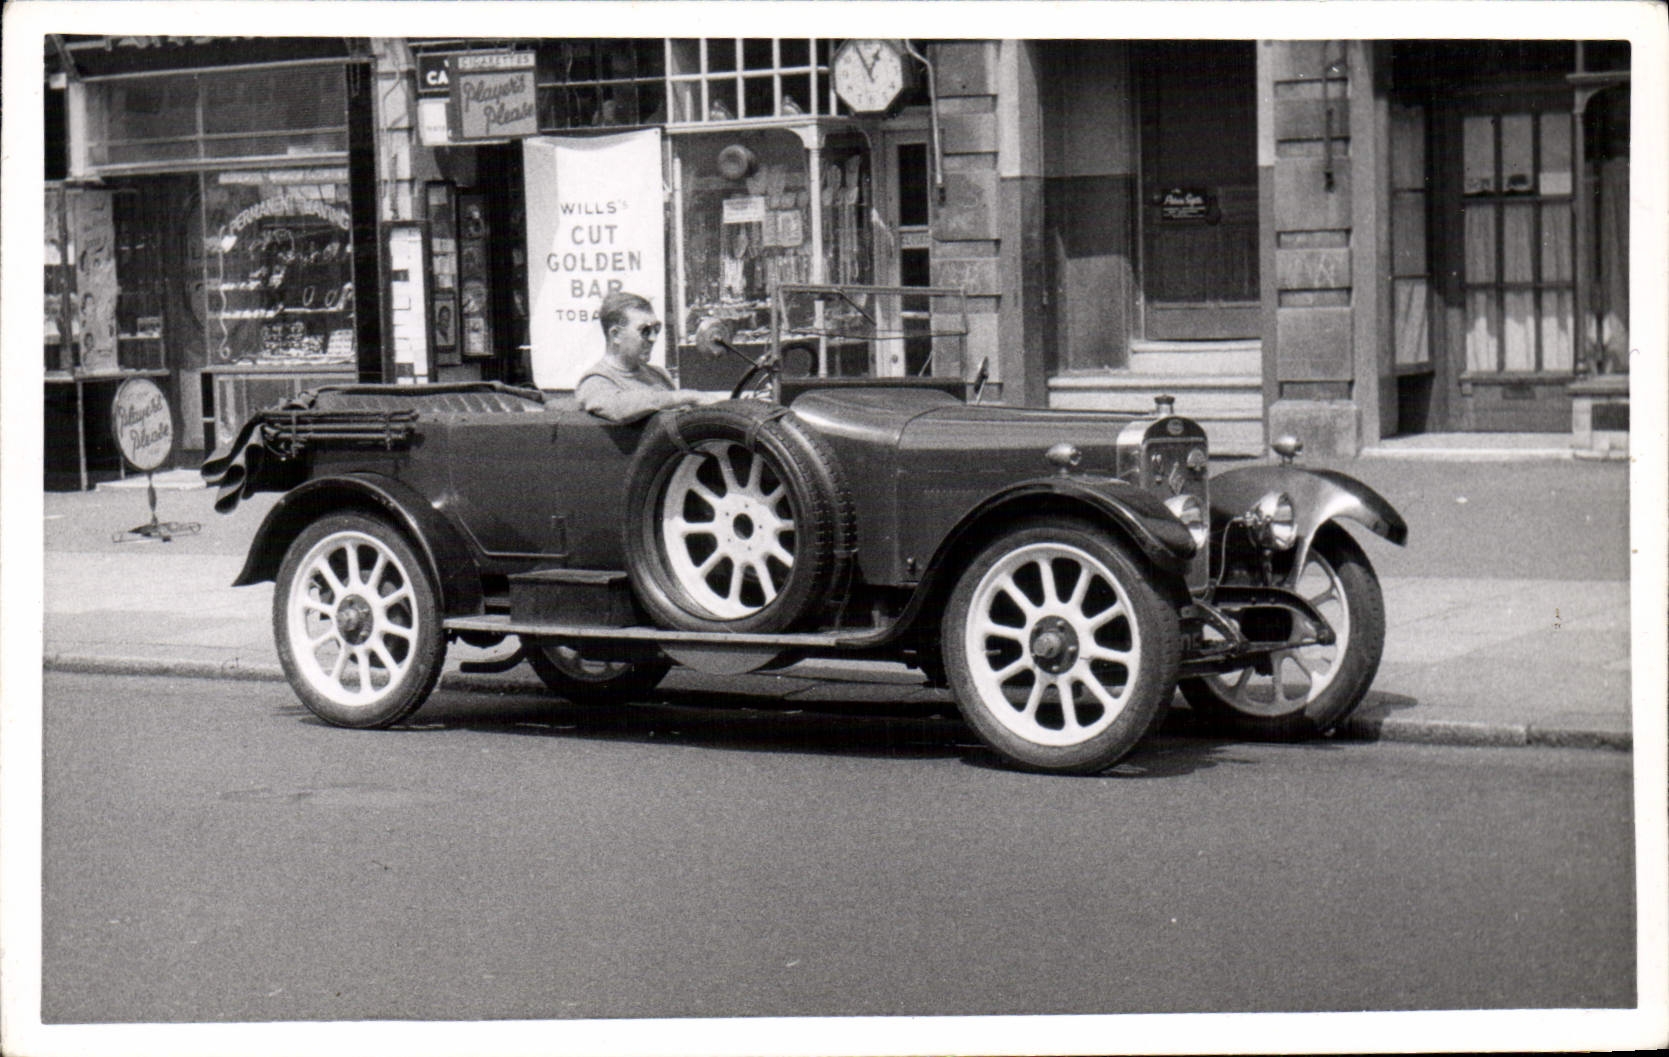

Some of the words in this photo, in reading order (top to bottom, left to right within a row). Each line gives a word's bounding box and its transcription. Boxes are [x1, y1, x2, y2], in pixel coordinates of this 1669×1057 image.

[426, 70, 449, 85] CA
[571, 224, 617, 244] CUT
[546, 250, 641, 272] GOLDEN
[571, 279, 623, 298] BAR
[556, 309, 600, 322] TOBA
